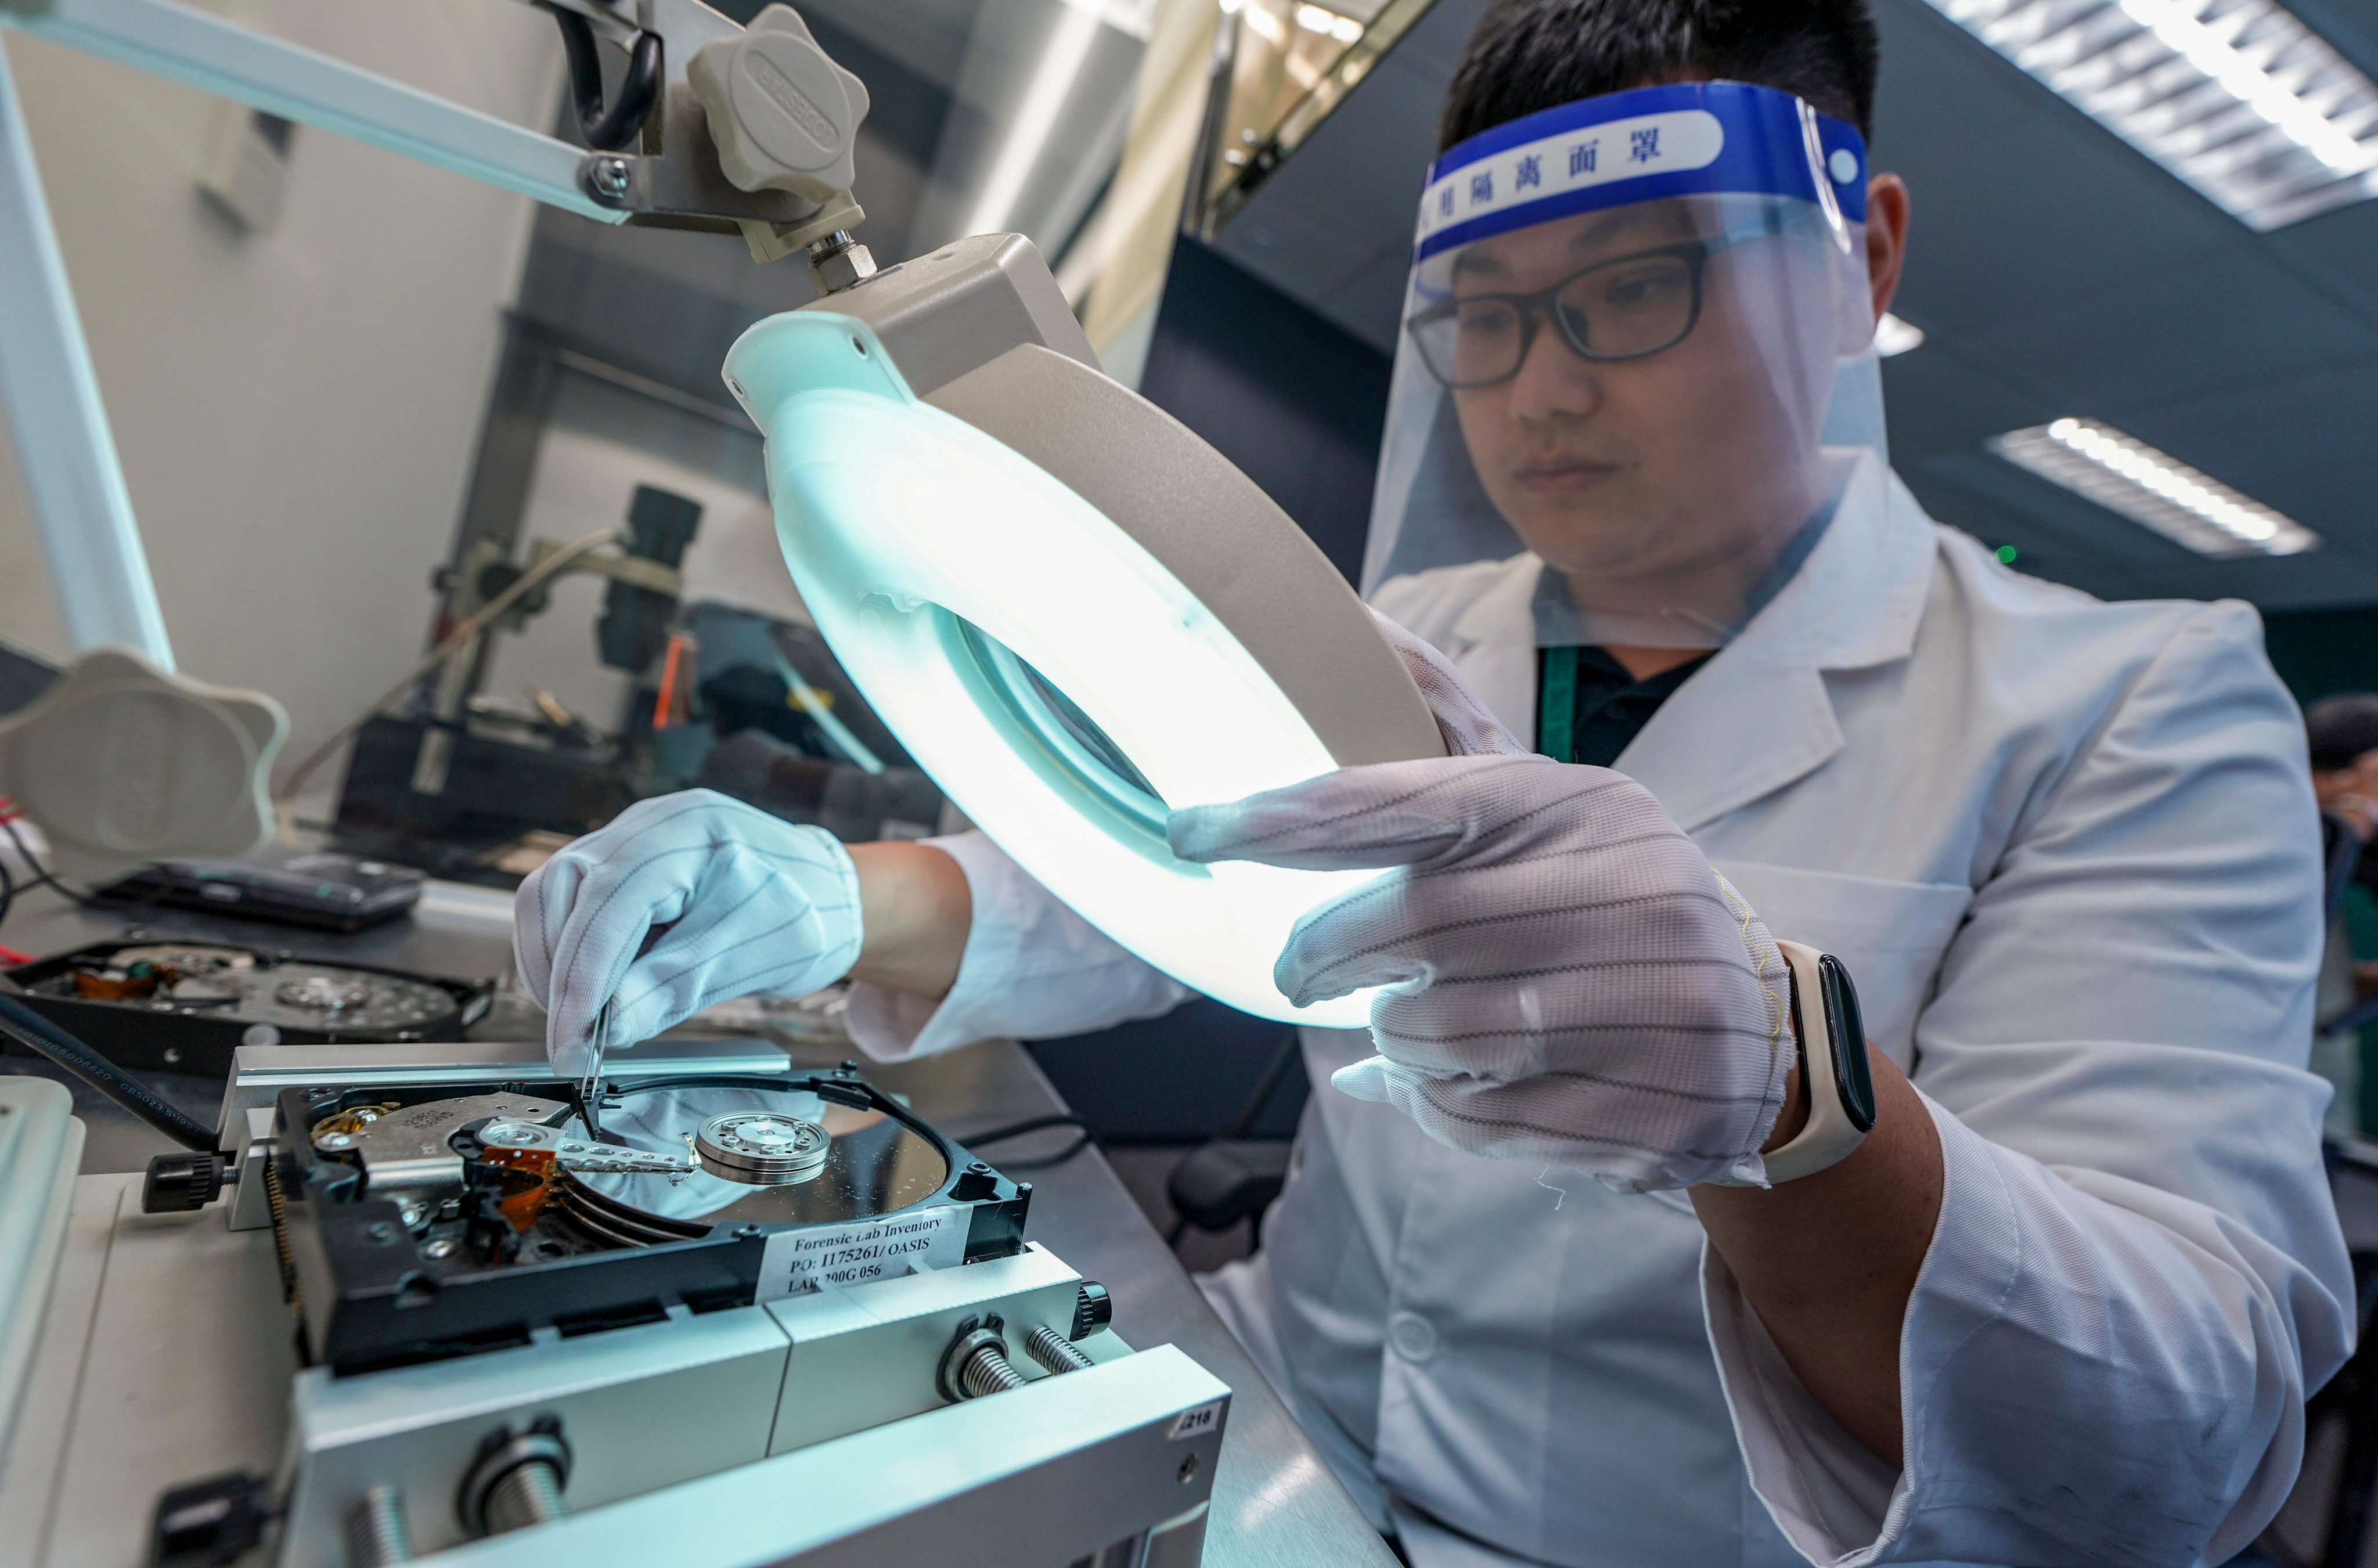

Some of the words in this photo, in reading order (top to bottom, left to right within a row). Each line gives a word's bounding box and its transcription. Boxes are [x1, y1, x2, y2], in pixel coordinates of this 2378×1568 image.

[1421, 127, 1662, 229] 用隔离面罩
[794, 1232, 852, 1252] Forensic
[856, 1227, 880, 1242] Lab
[884, 1218, 942, 1238] Inventory
[790, 1259, 817, 1274] PO:
[888, 1237, 930, 1256] OASIS
[859, 1264, 882, 1278] 056
